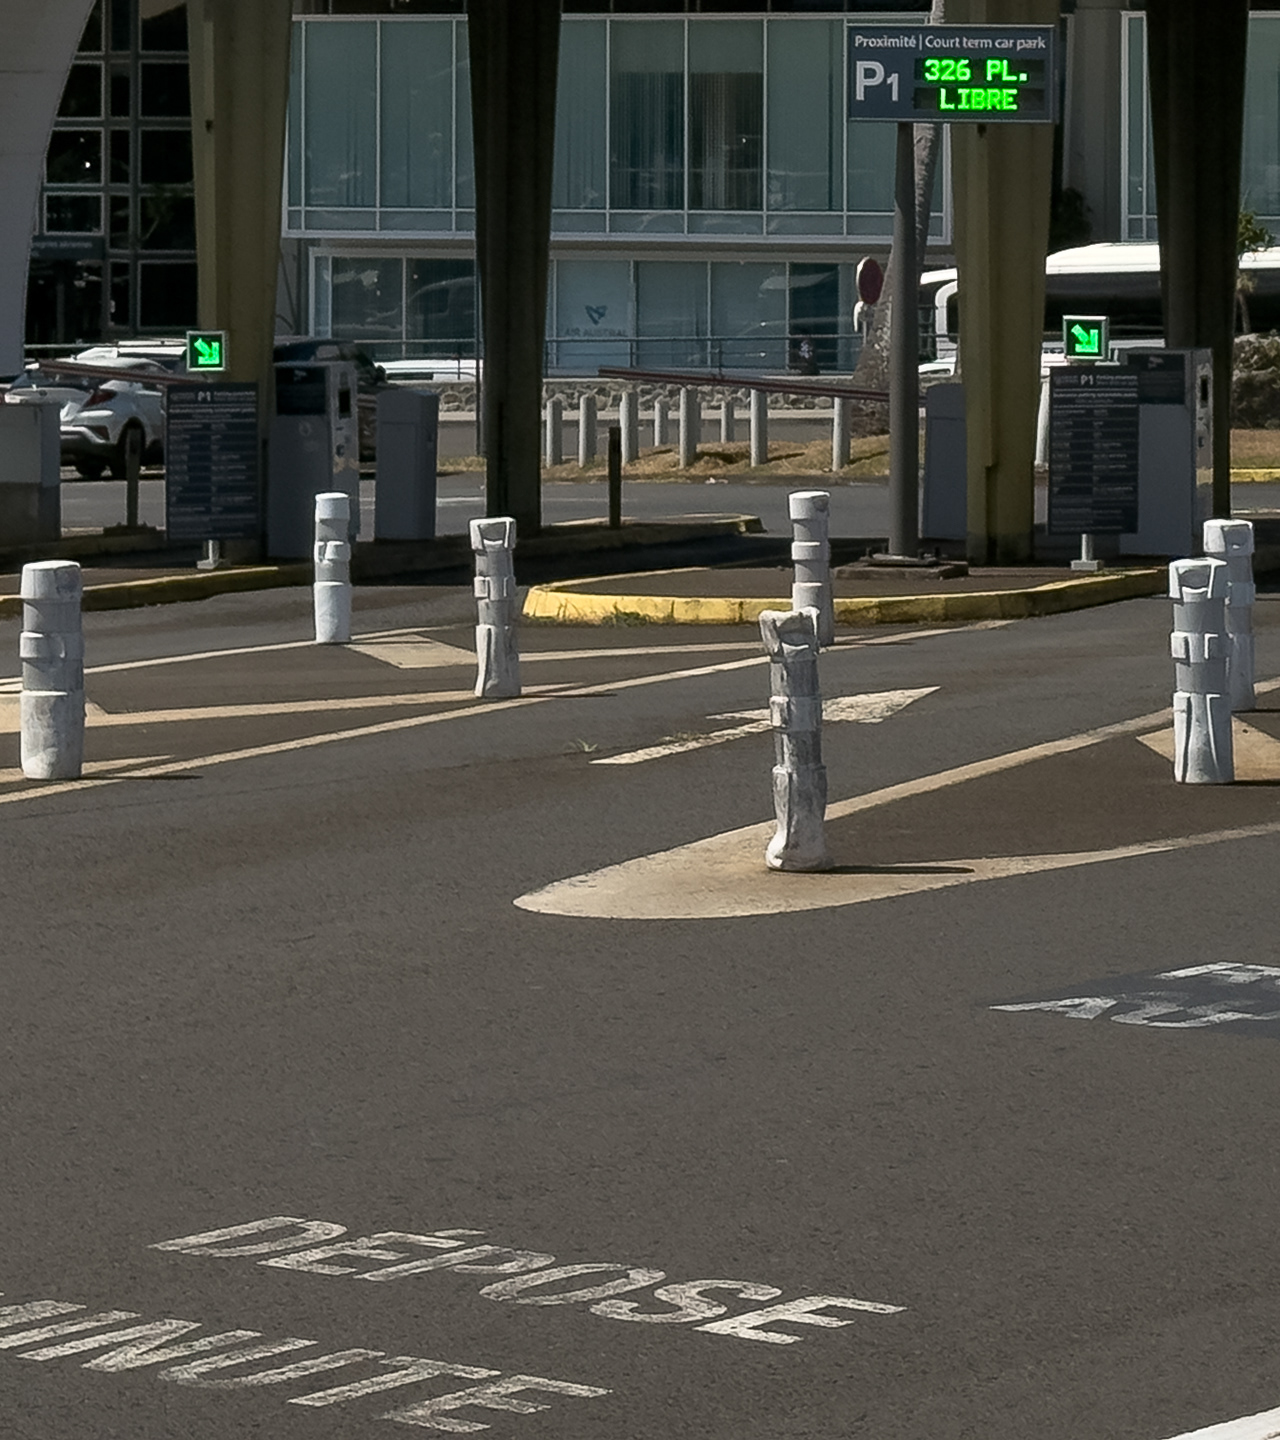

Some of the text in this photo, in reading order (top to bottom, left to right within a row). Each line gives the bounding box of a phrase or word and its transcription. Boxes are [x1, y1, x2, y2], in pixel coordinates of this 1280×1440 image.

[854, 34, 917, 49] Proximité
[924, 35, 962, 49] Court
[962, 37, 994, 49] term
[994, 38, 1015, 49] car
[1016, 36, 1047, 51] park
[855, 60, 900, 102] P1
[924, 59, 1029, 82] 326 PL.
[939, 87, 1018, 111] LIBRE
[148, 1215, 907, 1346] DÉPOSE
